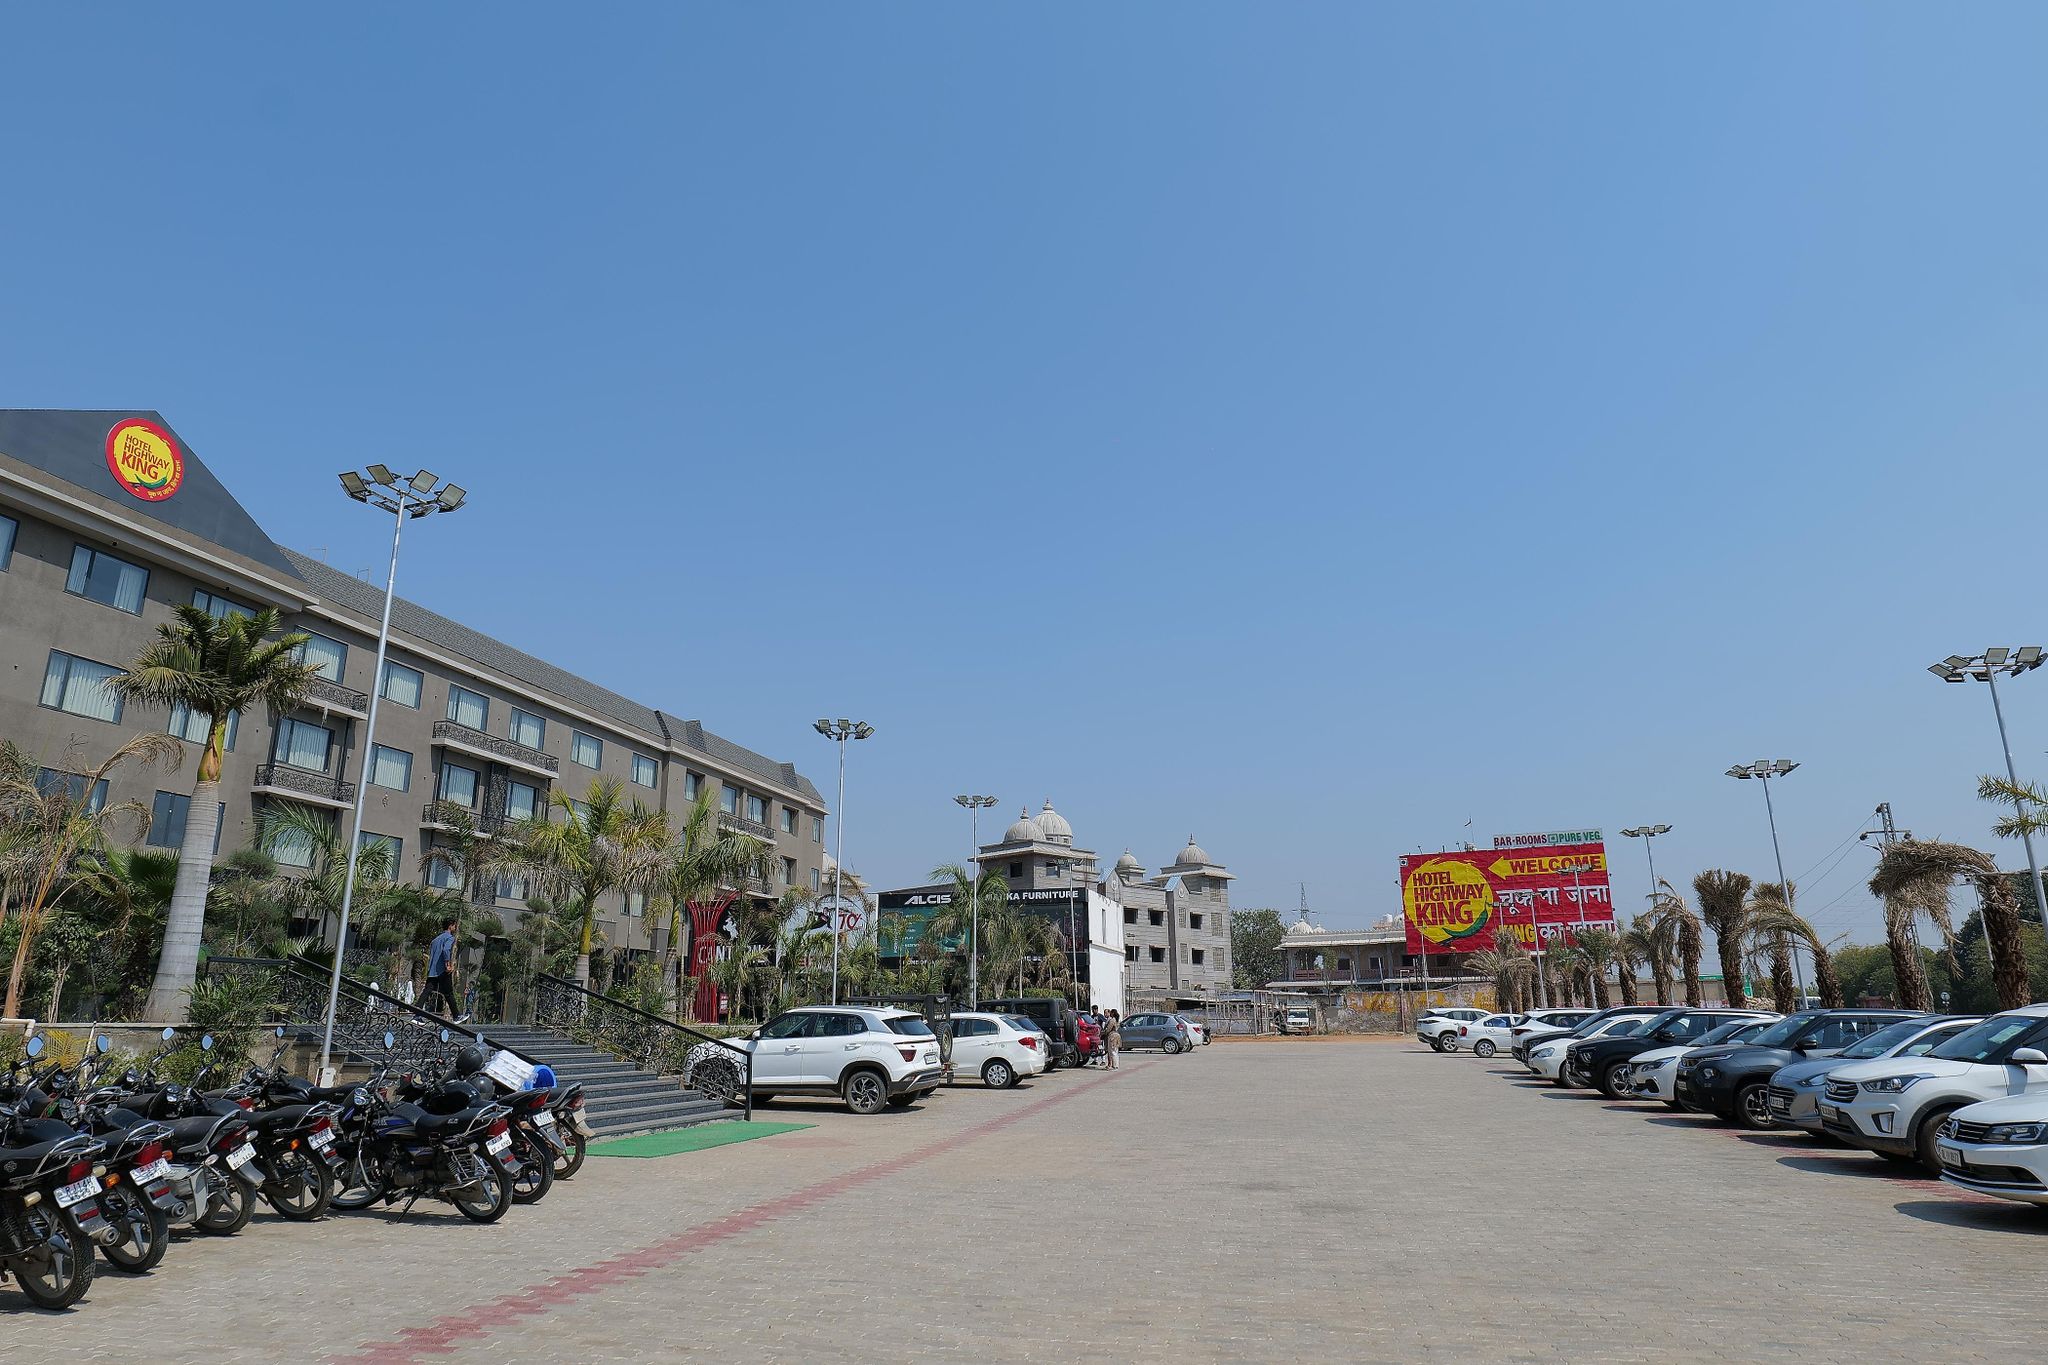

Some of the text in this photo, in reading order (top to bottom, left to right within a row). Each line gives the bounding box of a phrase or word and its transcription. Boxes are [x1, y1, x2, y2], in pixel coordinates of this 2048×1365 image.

[125, 434, 152, 453] HOTEL
[124, 442, 170, 469] HIGHWAY
[121, 451, 158, 480] KING
[1559, 832, 1581, 842] PURE
[1583, 831, 1603, 841] VEG.
[1510, 856, 1601, 873] WELCOME
[1413, 871, 1454, 886] HOTEL
[904, 894, 952, 905] ALCIS
[1022, 890, 1079, 900] FURNITURE
[1414, 884, 1484, 902] HIGHWAY
[1563, 885, 1608, 904] जाना
[1415, 900, 1473, 926] KING
